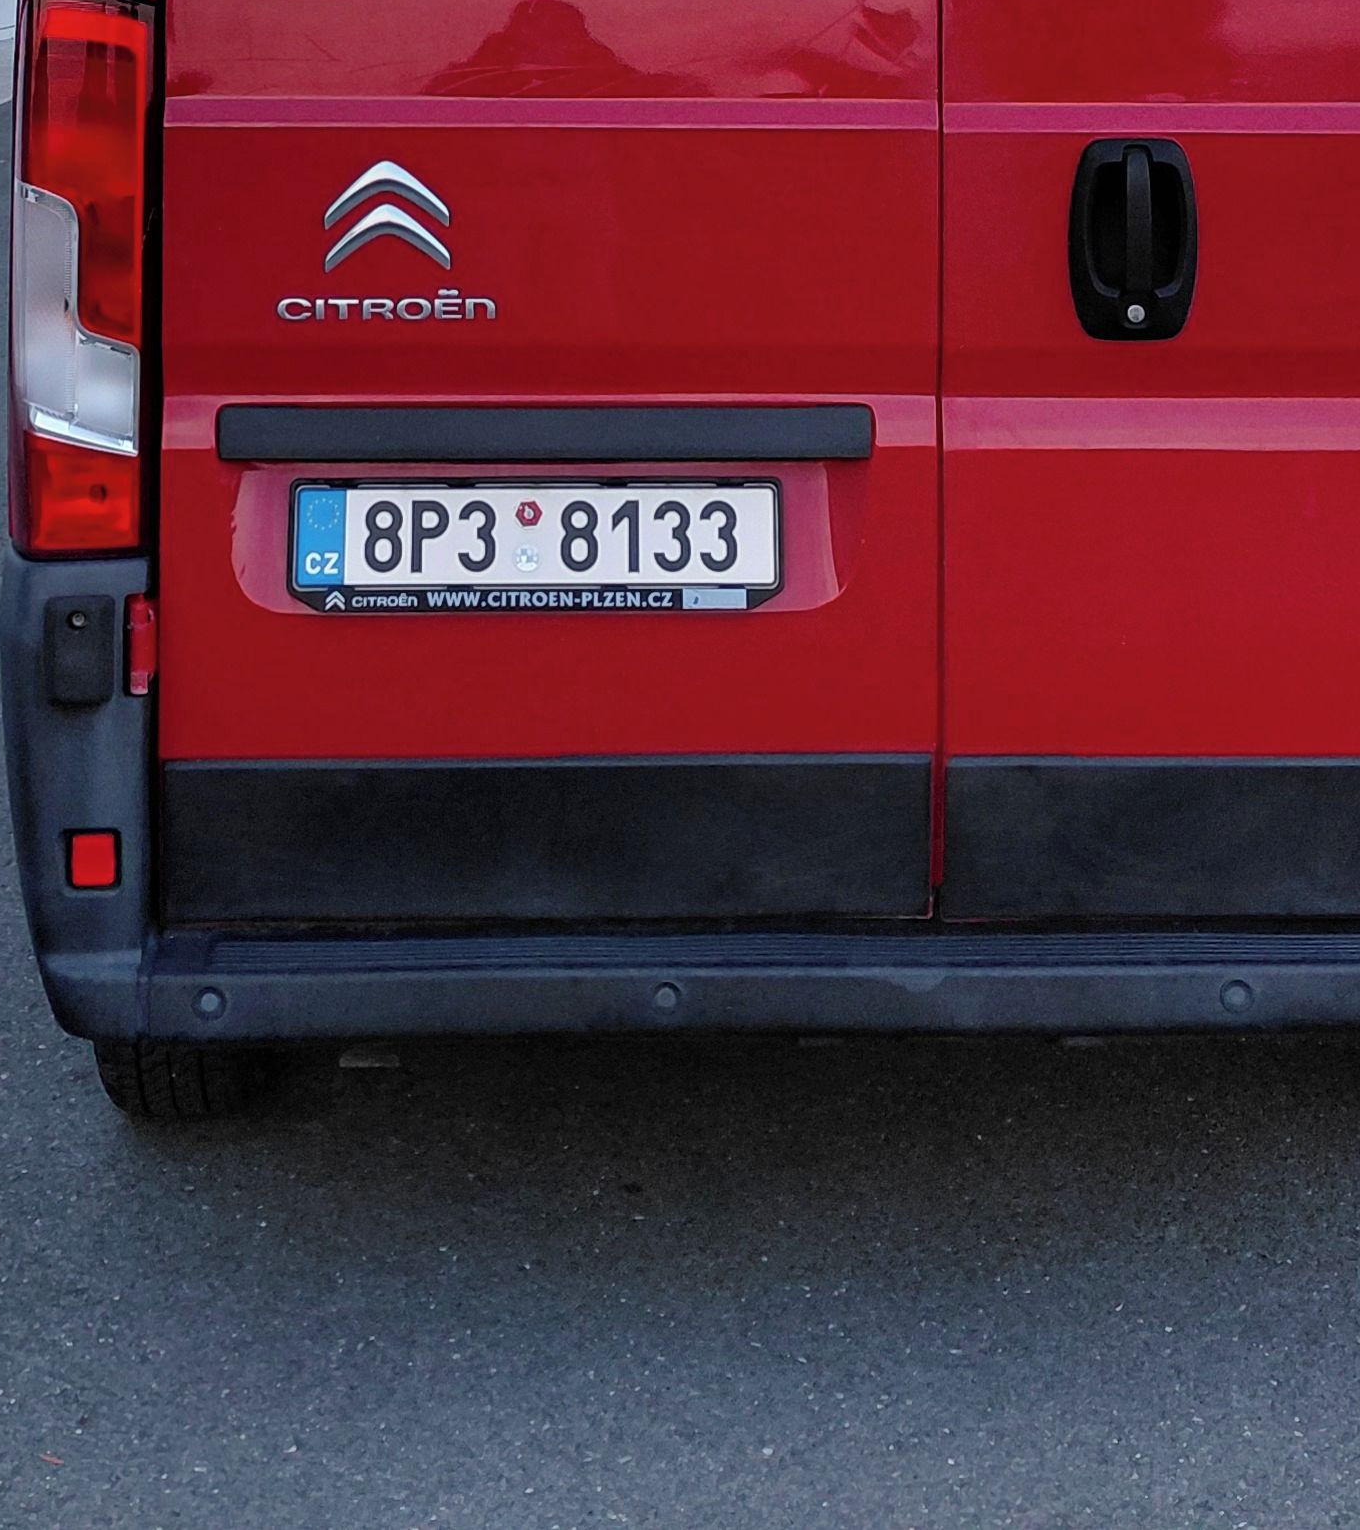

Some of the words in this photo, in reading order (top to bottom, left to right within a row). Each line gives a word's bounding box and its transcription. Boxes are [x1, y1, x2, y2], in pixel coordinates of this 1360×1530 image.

[364, 500, 497, 573] 8P3
[560, 500, 738, 573] 8133
[305, 552, 339, 574] CZ
[427, 591, 673, 607] WWW.CITROEN-PLZEN.CZ
